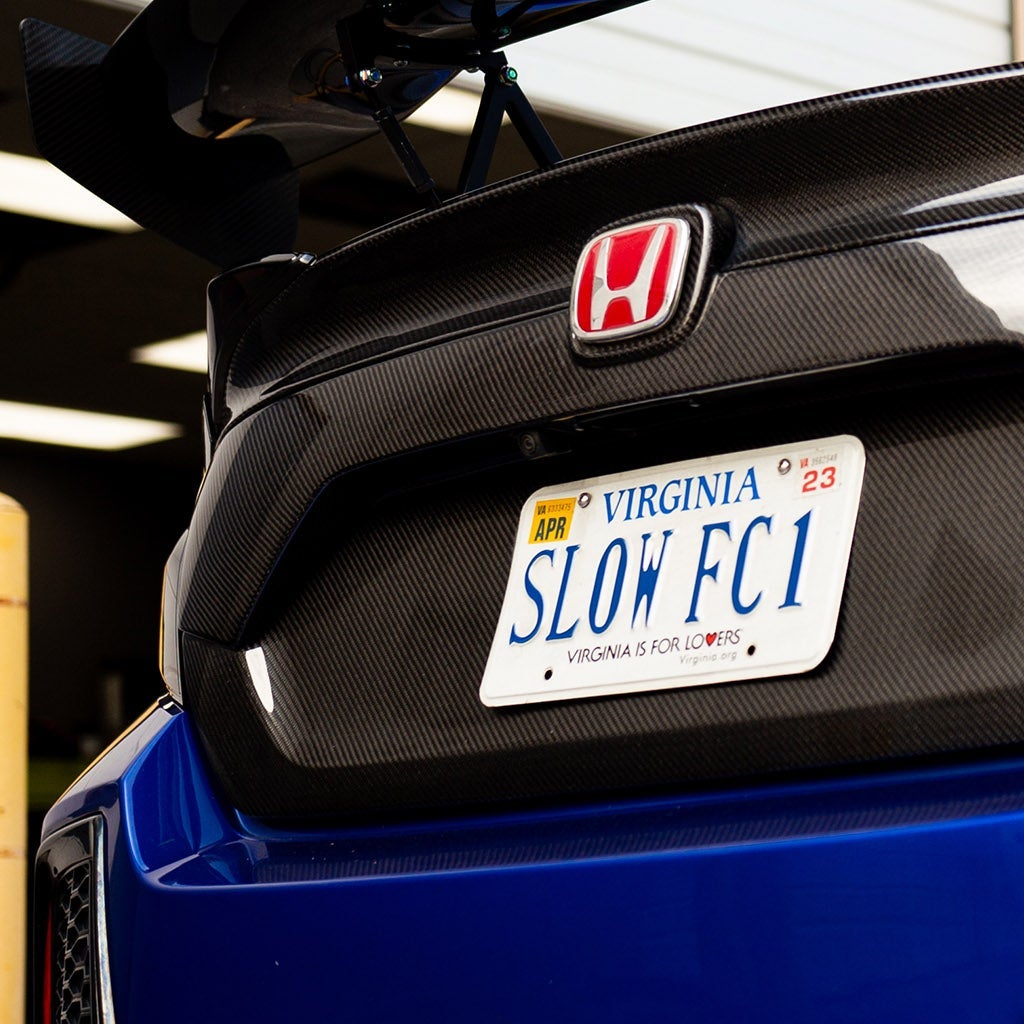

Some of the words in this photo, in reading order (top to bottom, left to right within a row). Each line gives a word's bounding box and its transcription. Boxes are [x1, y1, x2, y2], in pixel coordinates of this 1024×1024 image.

[802, 466, 836, 492] 23
[603, 466, 761, 525] VIRGINIA
[537, 504, 546, 515] VA
[534, 516, 567, 541] APR
[509, 528, 674, 645] SLOW
[684, 507, 814, 624] FC1
[567, 643, 632, 663] VIRGINIA
[635, 640, 647, 657] IS
[650, 637, 681, 655] FOR
